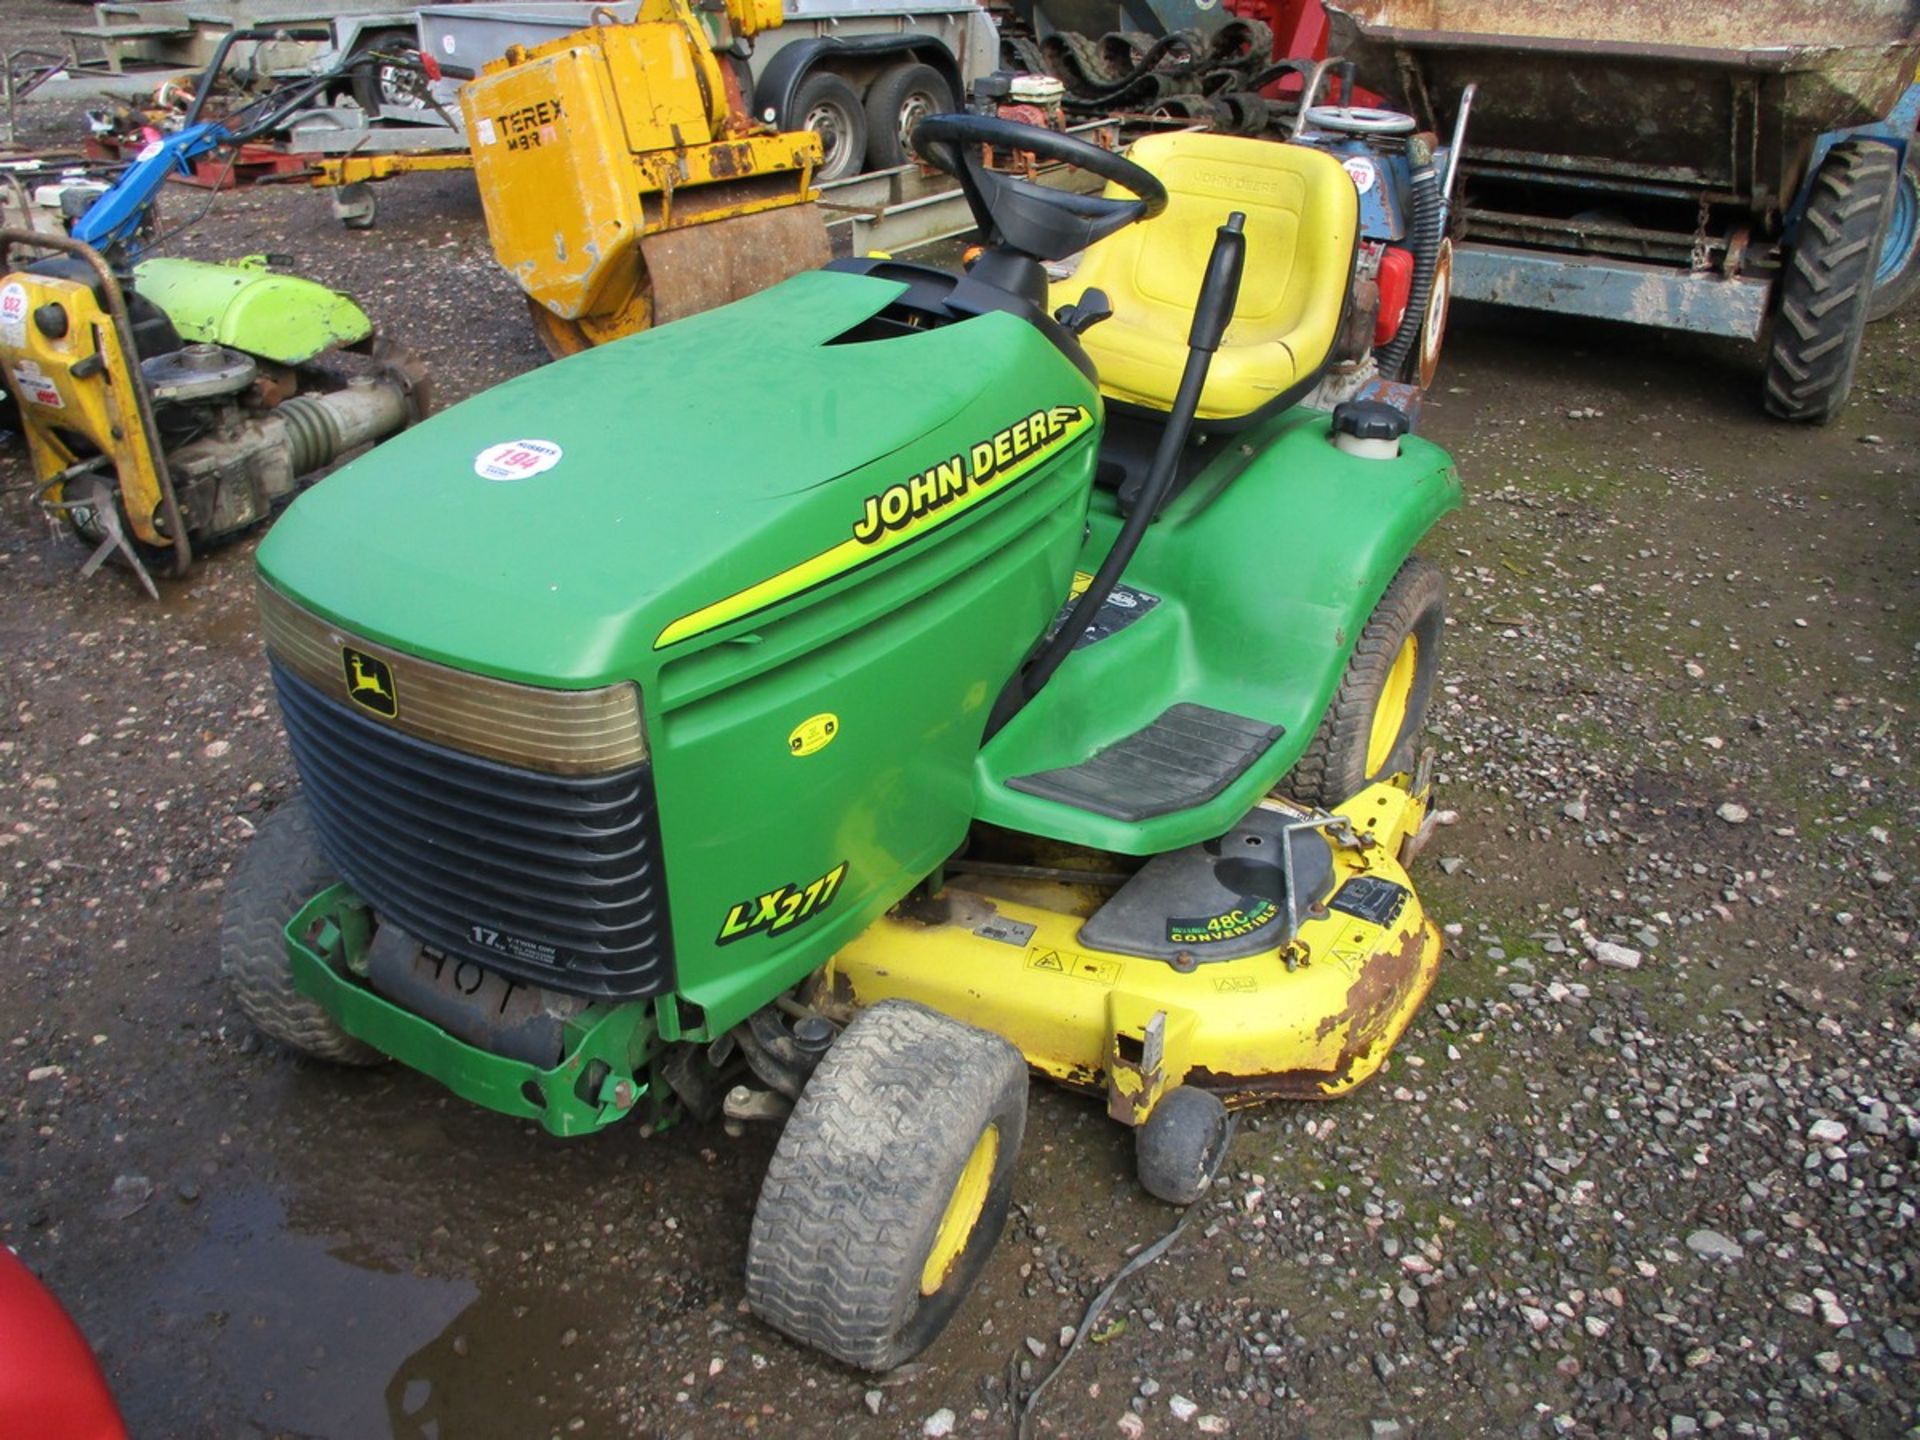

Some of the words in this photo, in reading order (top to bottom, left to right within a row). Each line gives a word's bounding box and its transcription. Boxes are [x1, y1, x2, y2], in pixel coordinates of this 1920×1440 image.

[496, 99, 567, 136] TEREX
[494, 448, 540, 469] 194
[853, 455, 967, 543] JOHN
[970, 406, 1081, 486] DEERE
[715, 860, 849, 947] LX277
[1171, 903, 1279, 942] CONVERTIBLE
[1207, 909, 1249, 932] 48C
[472, 926, 499, 946] 17
[415, 944, 528, 1014] HOT
